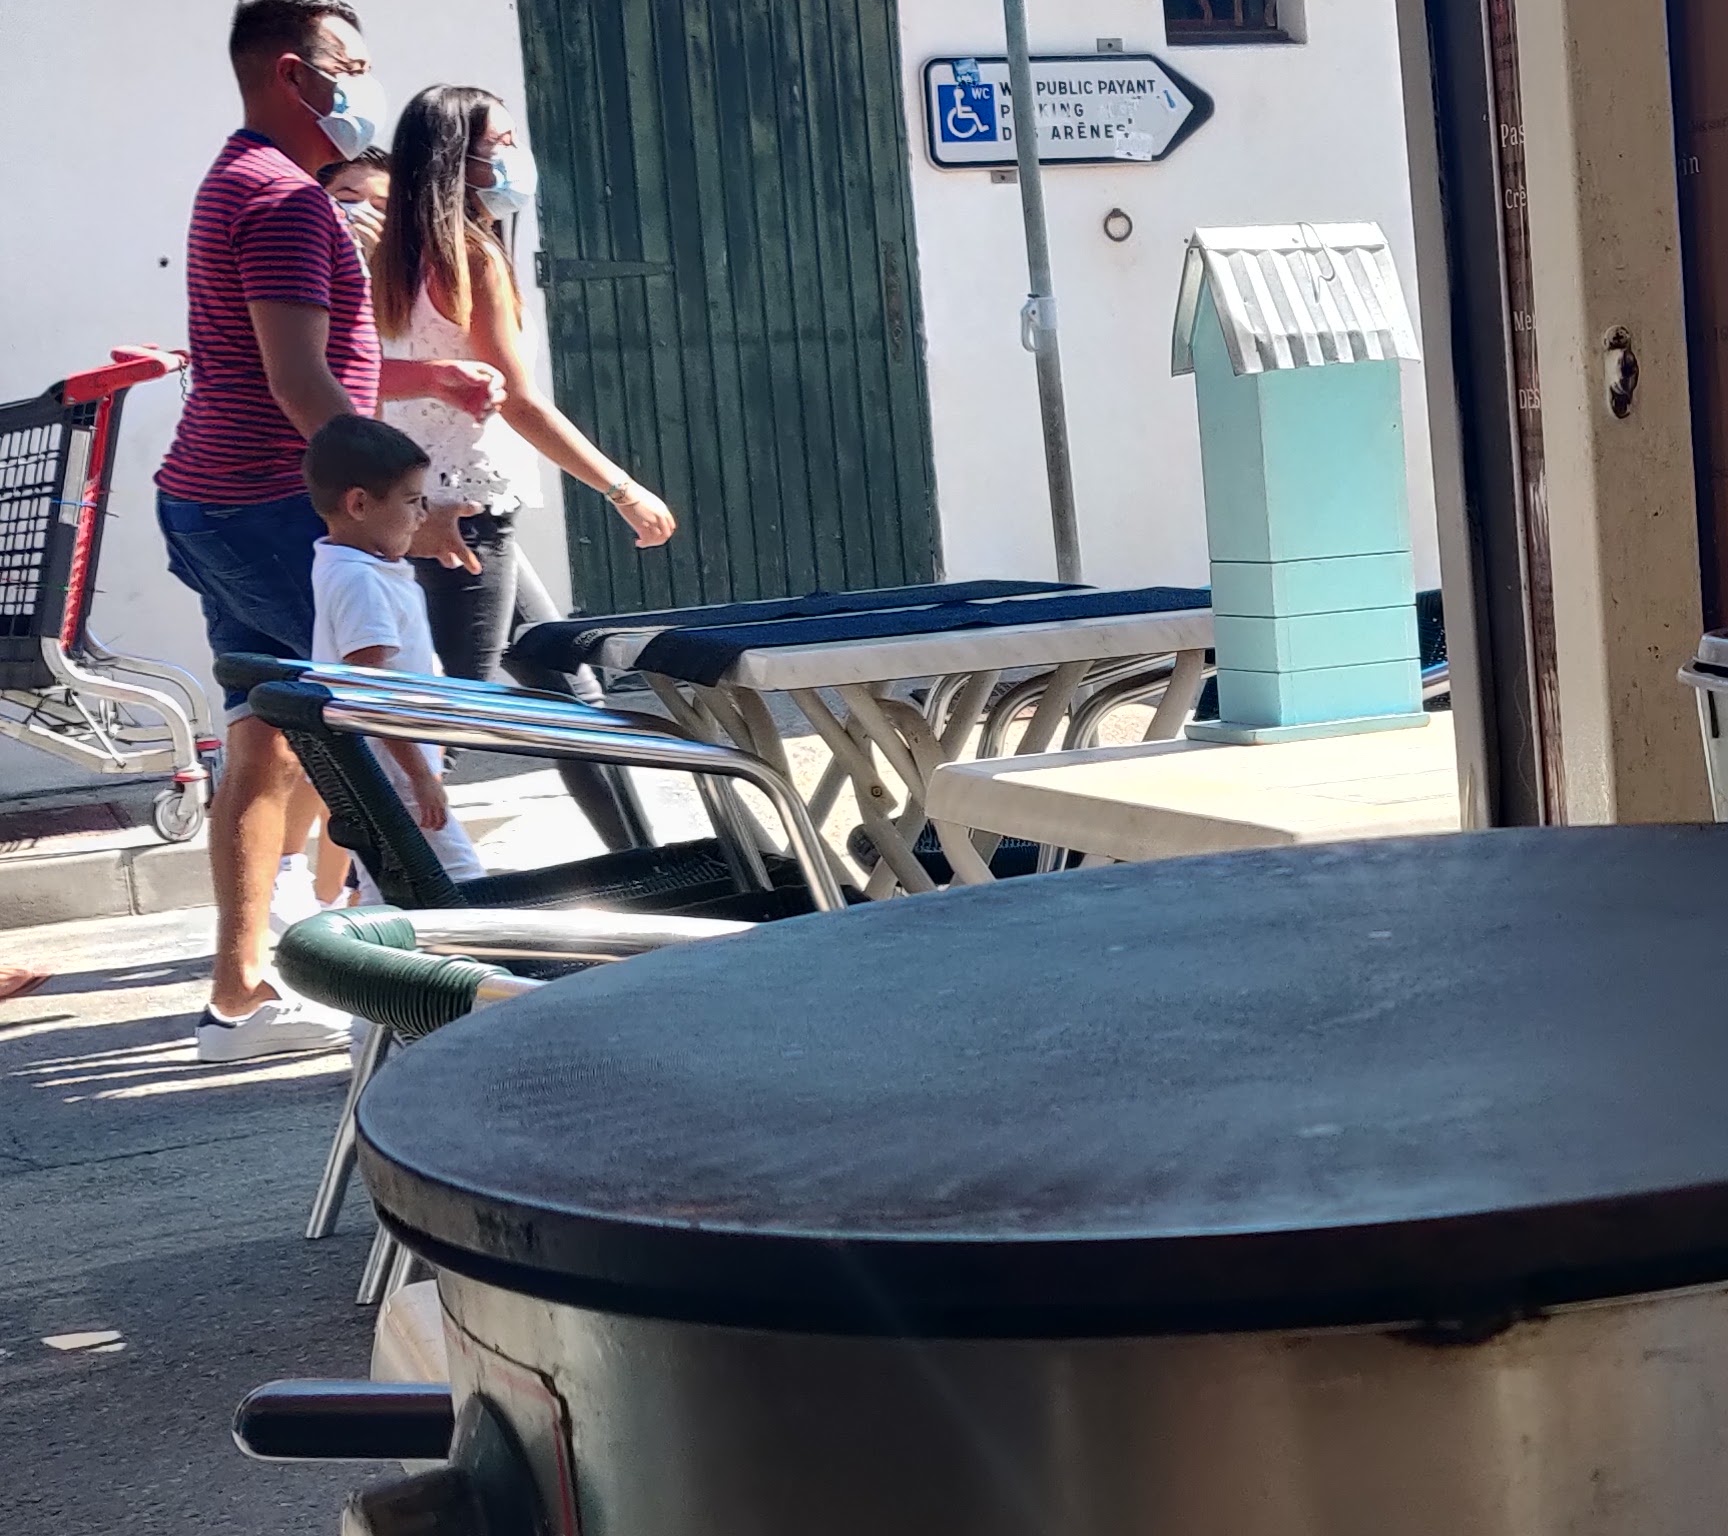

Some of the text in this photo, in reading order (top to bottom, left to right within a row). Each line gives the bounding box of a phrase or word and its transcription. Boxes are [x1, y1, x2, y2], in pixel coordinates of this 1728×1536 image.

[971, 87, 990, 100] WC
[1036, 80, 1093, 96] PUBLIC
[1098, 79, 1156, 95] PAYANT
[1000, 102, 1084, 118] PKING
